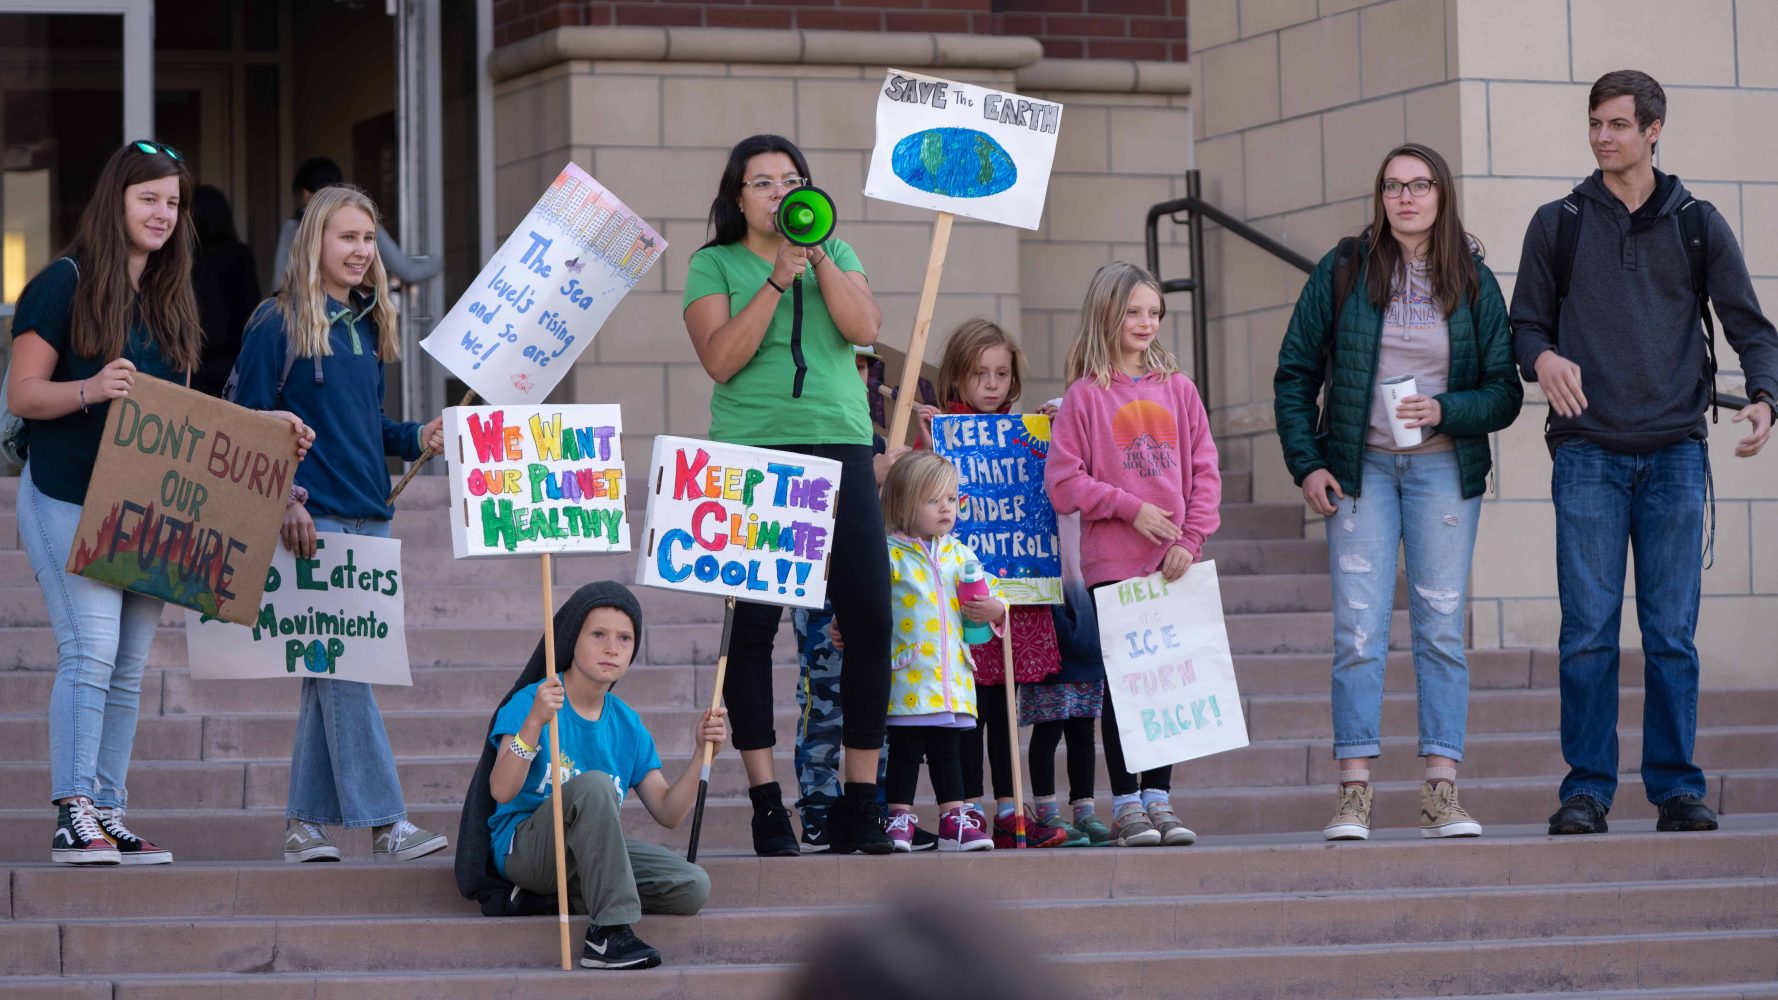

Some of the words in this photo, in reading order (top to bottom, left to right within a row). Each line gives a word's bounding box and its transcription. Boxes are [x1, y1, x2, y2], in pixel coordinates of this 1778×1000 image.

[885, 75, 948, 109] SAVE
[953, 90, 974, 107] The
[983, 94, 1059, 134] EARTH
[519, 231, 553, 278] The
[468, 301, 502, 325] and
[498, 323, 518, 343] so
[522, 345, 551, 367] are
[488, 266, 534, 314] level's
[538, 310, 576, 358] rising
[113, 398, 205, 463] DON'T
[207, 430, 289, 500] BURN
[466, 410, 524, 463] WE
[528, 412, 615, 461] WANT
[942, 418, 1013, 450] KEEP
[160, 469, 208, 522] OUR
[467, 468, 522, 496] OUR
[528, 463, 623, 503] PLANET
[672, 448, 765, 507] KEEP
[767, 462, 833, 512] THE
[951, 456, 1029, 485] LIMATE
[480, 497, 623, 551] HEALTHY
[956, 494, 1026, 522] UNDER
[107, 499, 247, 600] FUTURE
[657, 529, 812, 597] COOL!!
[952, 531, 1060, 563] ONTROL!
[252, 603, 389, 641] Movimiento
[1125, 624, 1181, 659] ICE
[1122, 658, 1197, 697] TURN
[1140, 694, 1223, 742] BACK!
